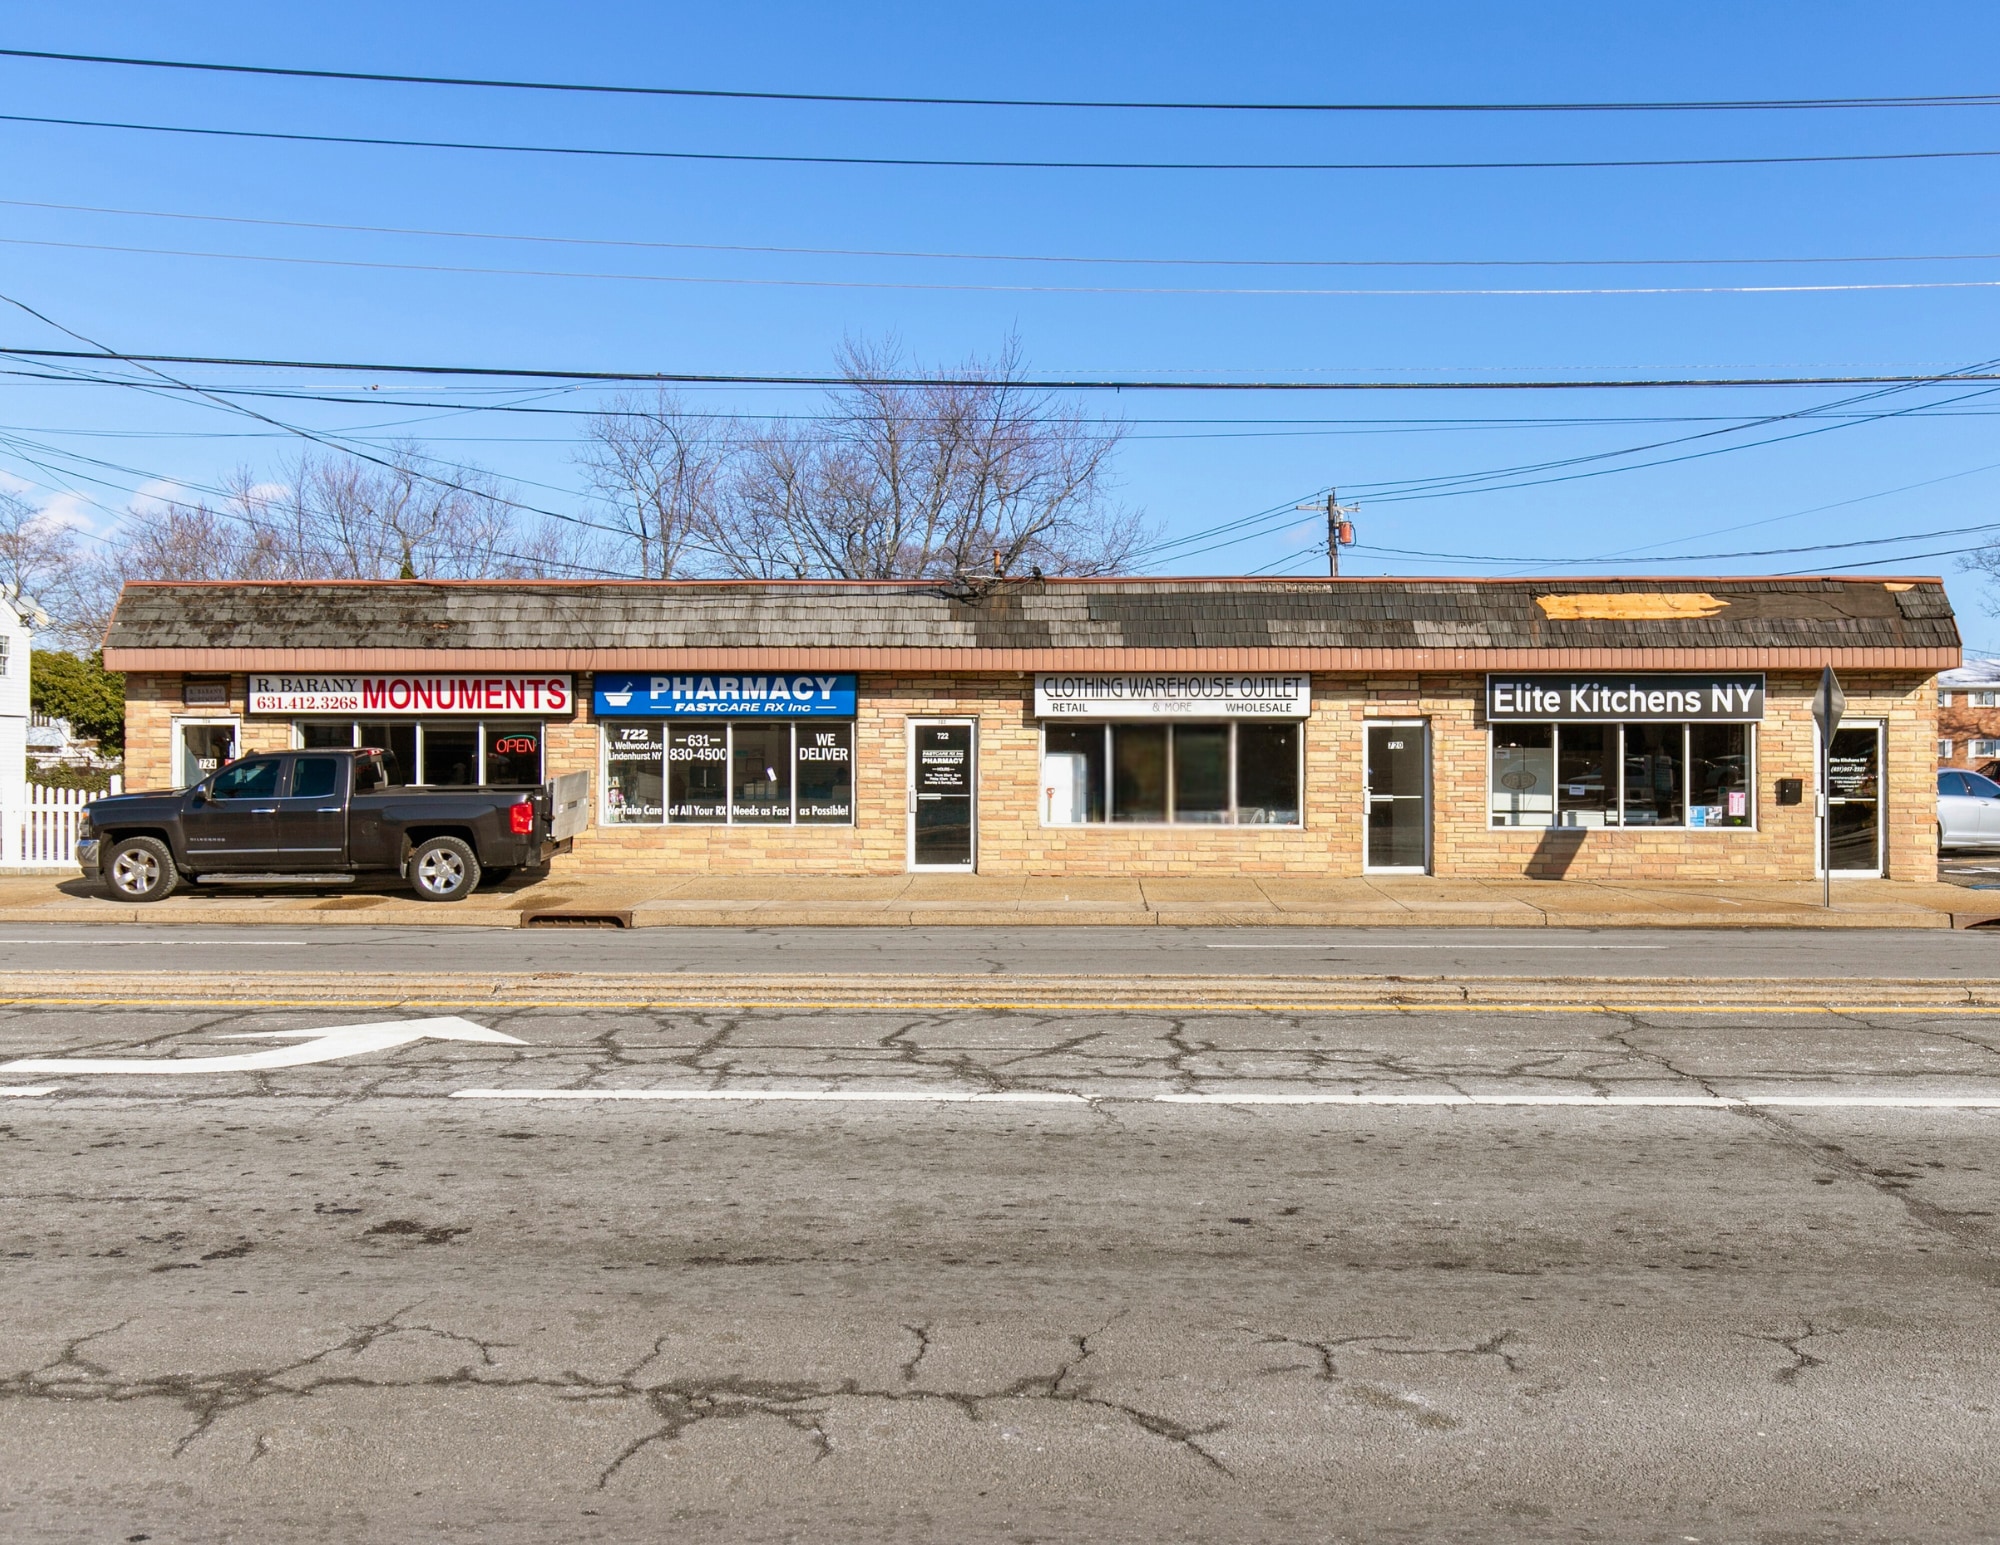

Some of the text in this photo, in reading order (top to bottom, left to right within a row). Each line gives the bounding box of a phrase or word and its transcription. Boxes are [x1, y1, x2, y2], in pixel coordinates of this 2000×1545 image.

[256, 678, 358, 693] R. BARANY
[650, 676, 837, 701] PHARMACY
[1043, 677, 1302, 698] CLOTHING WAREHOUSE OUTLET
[363, 679, 565, 709] MONUMENTS
[1494, 683, 1757, 713] Elite Kitchens NY
[257, 696, 358, 710] 631.412.3268
[674, 702, 811, 712] FASTCARE RX Inc
[1052, 702, 1292, 713] RETAIL & MORE WHOLESALE
[620, 729, 649, 740] 722
[816, 733, 836, 746] WE
[937, 732, 949, 740] 722
[496, 738, 536, 753] OPEN
[615, 741, 648, 750] Wellwood
[650, 742, 663, 750] Ave
[609, 752, 662, 760] Lindenhurst NY
[669, 748, 727, 760] 830-4500
[799, 748, 848, 760] DELIVER
[200, 760, 216, 768] 724
[620, 804, 642, 815] Take
[643, 805, 662, 815] Care
[669, 805, 679, 815] of
[680, 805, 692, 815] All
[693, 805, 713, 815] Your
[715, 805, 727, 815] RX
[732, 805, 759, 816] Needs
[760, 807, 770, 816] as
[772, 806, 790, 816] Fast
[799, 807, 810, 816] as
[811, 805, 849, 816] Possible!
